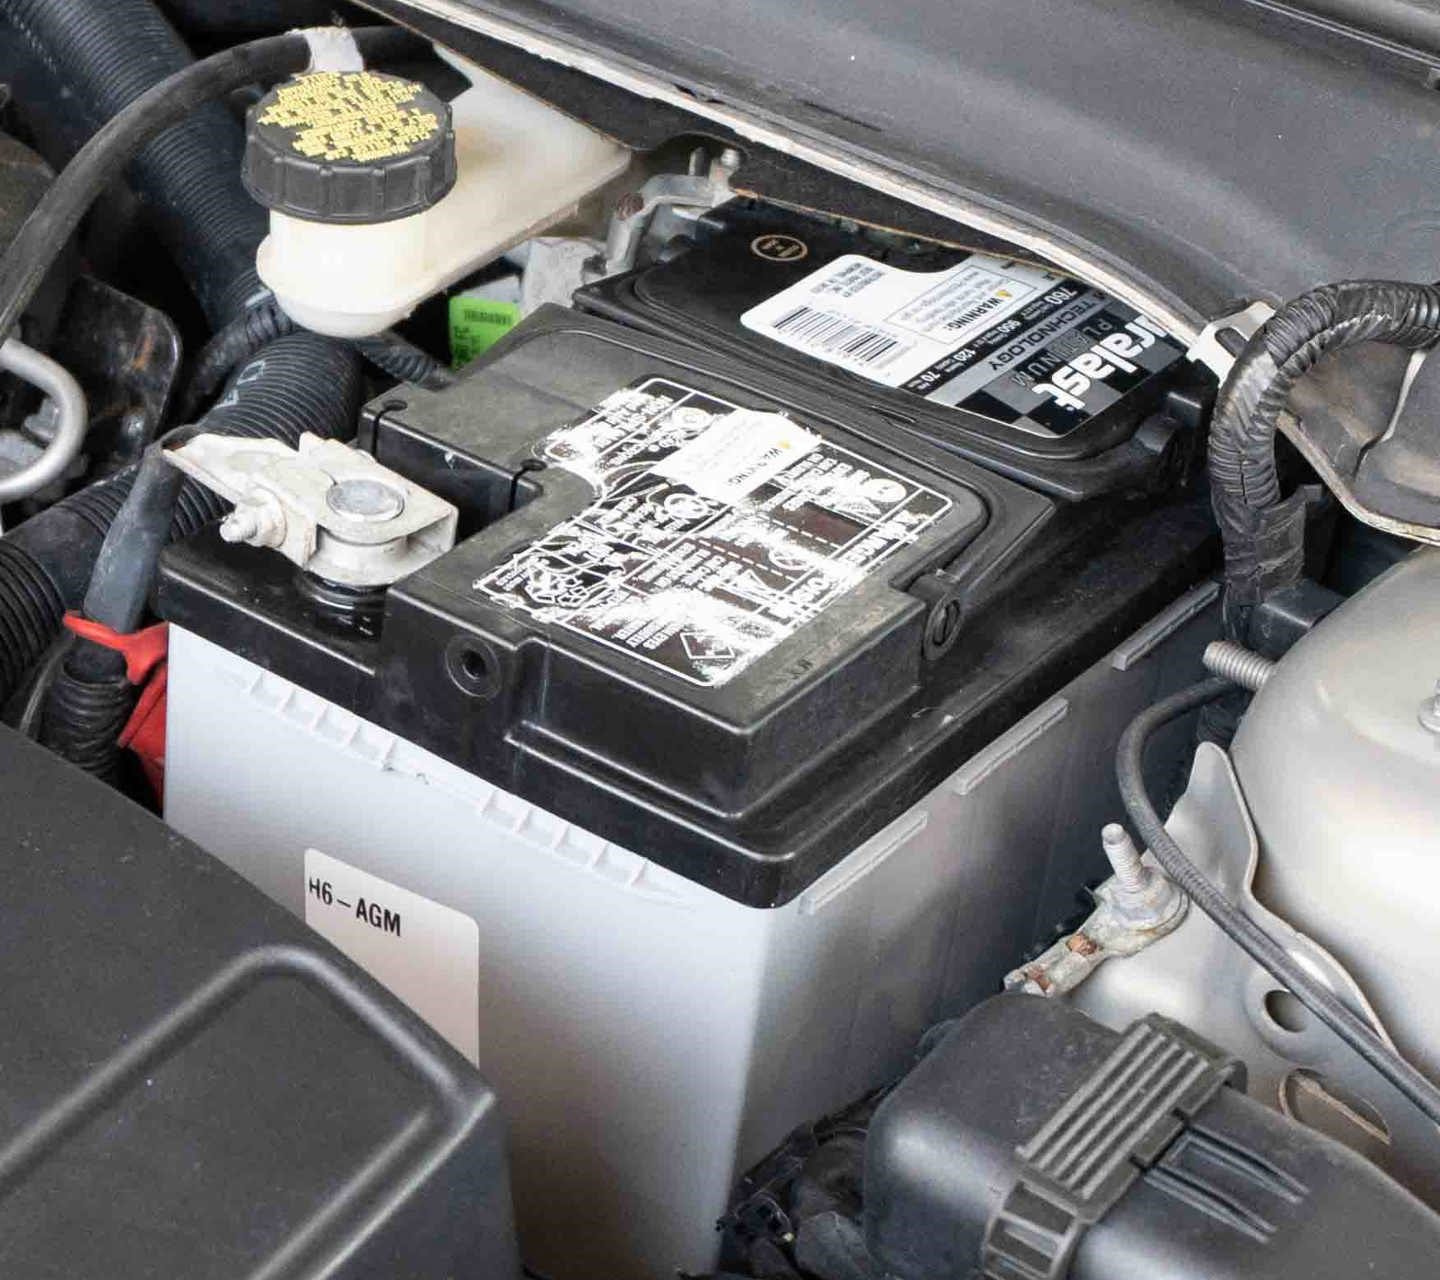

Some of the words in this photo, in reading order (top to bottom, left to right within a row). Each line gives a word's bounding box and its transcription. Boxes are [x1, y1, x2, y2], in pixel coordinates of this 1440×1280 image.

[1044, 287, 1077, 306] 760
[991, 300, 1098, 371] TECHNOLOGY
[1010, 317, 1116, 388] PLATINUM
[922, 371, 941, 383] 70
